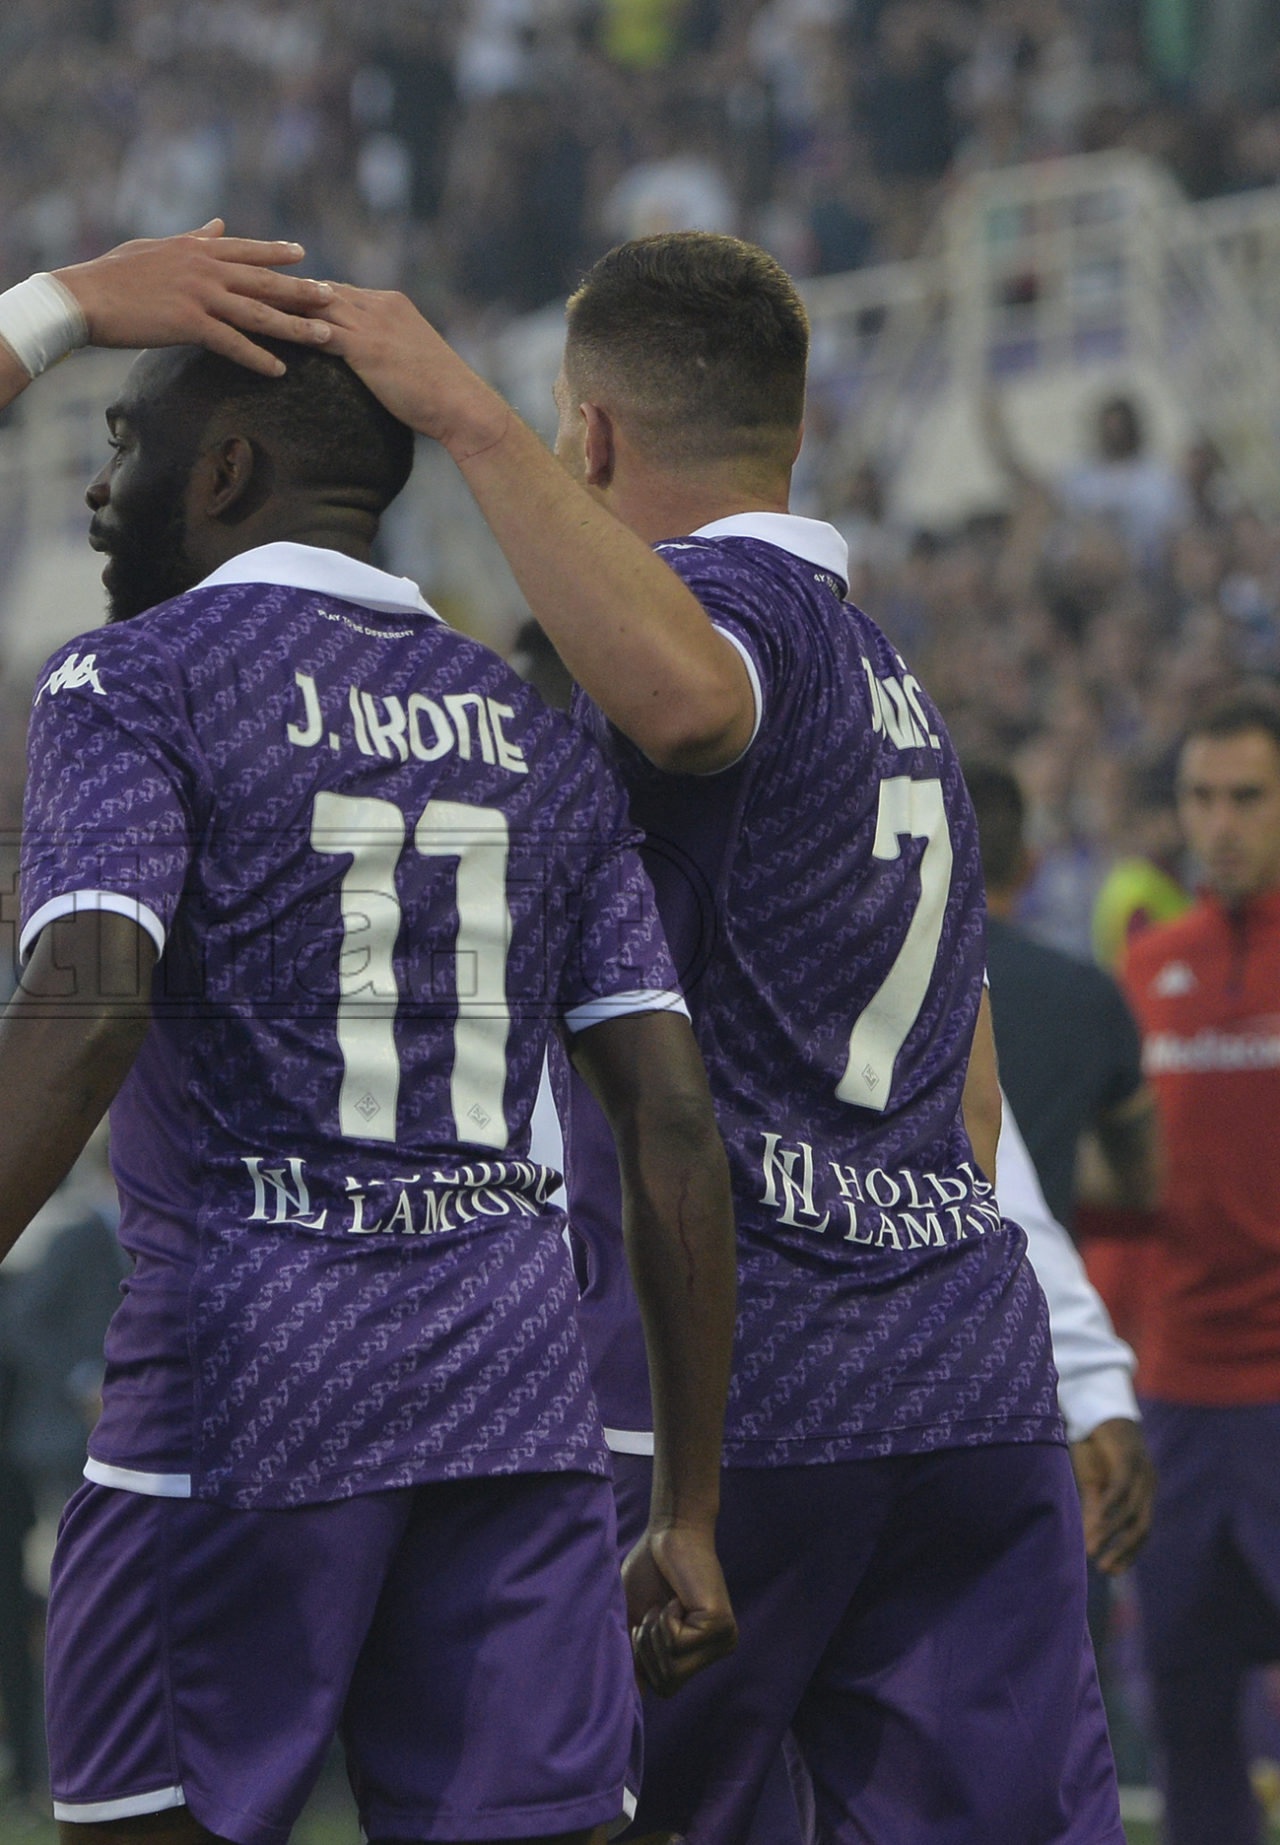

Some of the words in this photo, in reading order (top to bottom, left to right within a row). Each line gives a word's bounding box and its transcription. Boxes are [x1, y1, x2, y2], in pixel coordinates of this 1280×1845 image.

[287, 671, 340, 751] J.
[349, 684, 529, 774] IKONE
[310, 791, 512, 1150] 11
[835, 775, 953, 1111] 7
